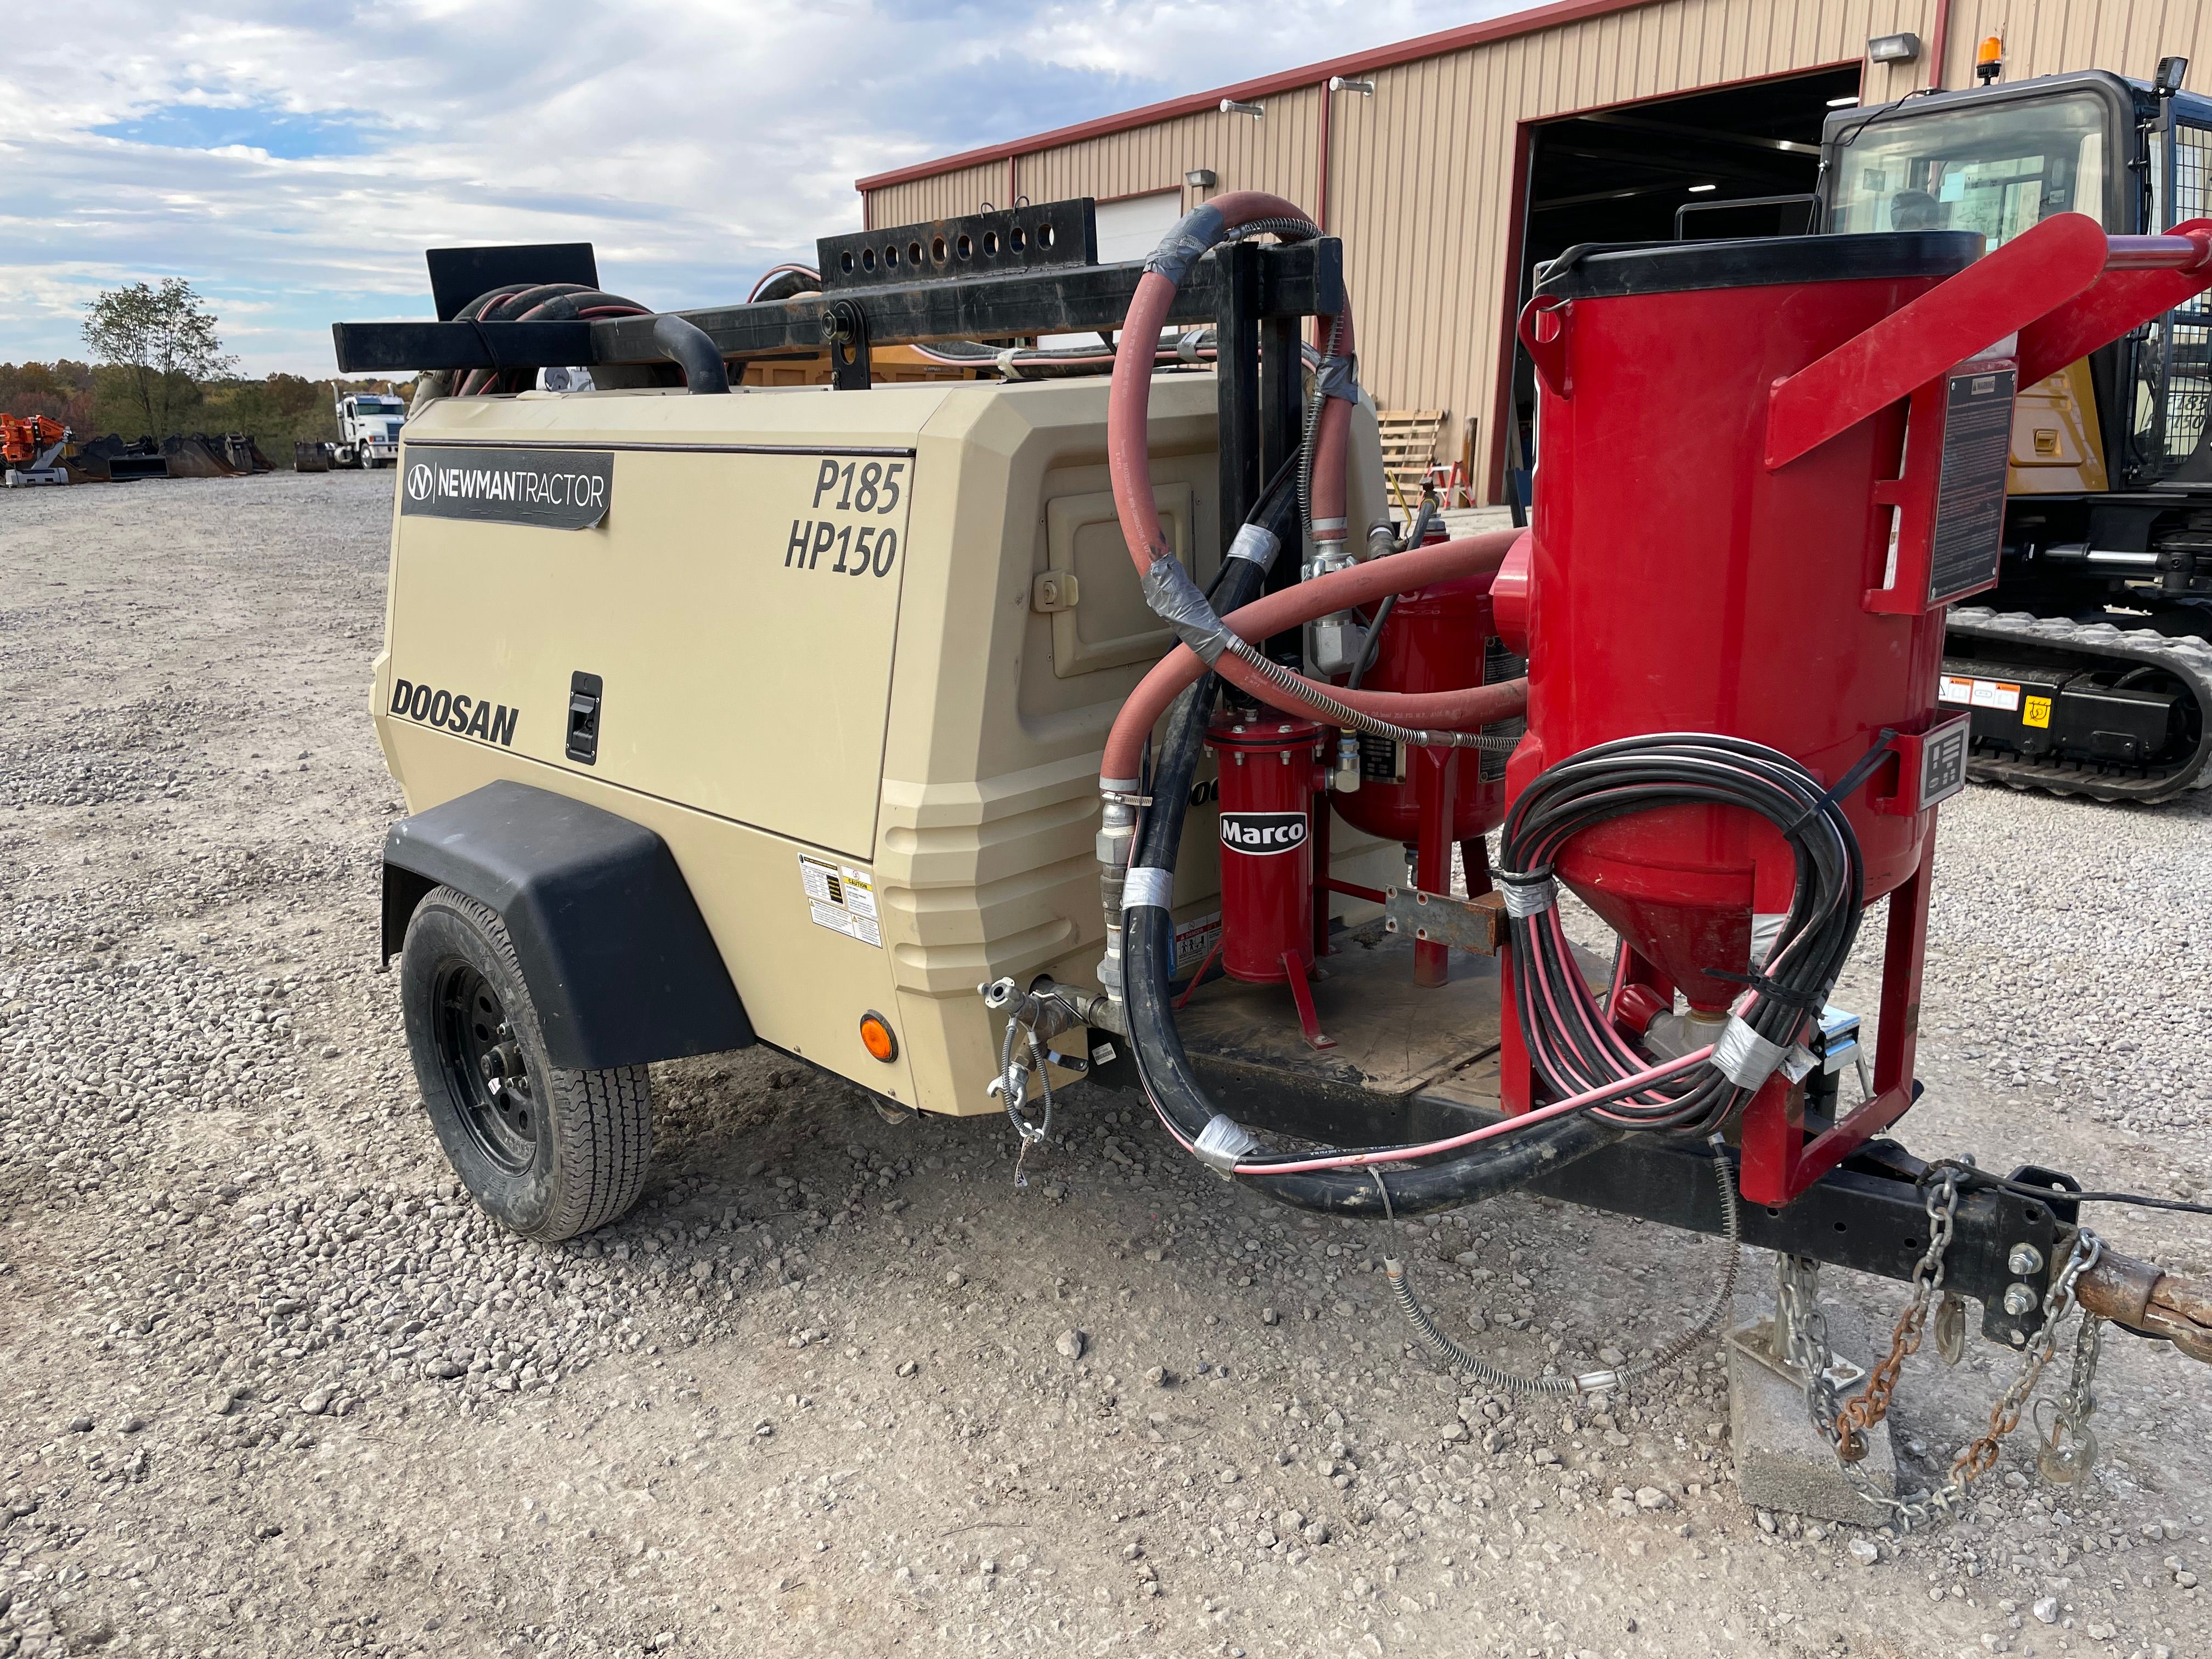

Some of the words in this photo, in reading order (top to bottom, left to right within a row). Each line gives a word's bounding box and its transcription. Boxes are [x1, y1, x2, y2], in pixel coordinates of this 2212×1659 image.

[812, 459, 905, 514] P185
[785, 520, 897, 578] HP150
[391, 679, 519, 747] DOOSAN
[1223, 819, 1304, 844] Marco
[848, 878, 867, 889] CAUTION
[1186, 928, 1203, 938] DANGER
